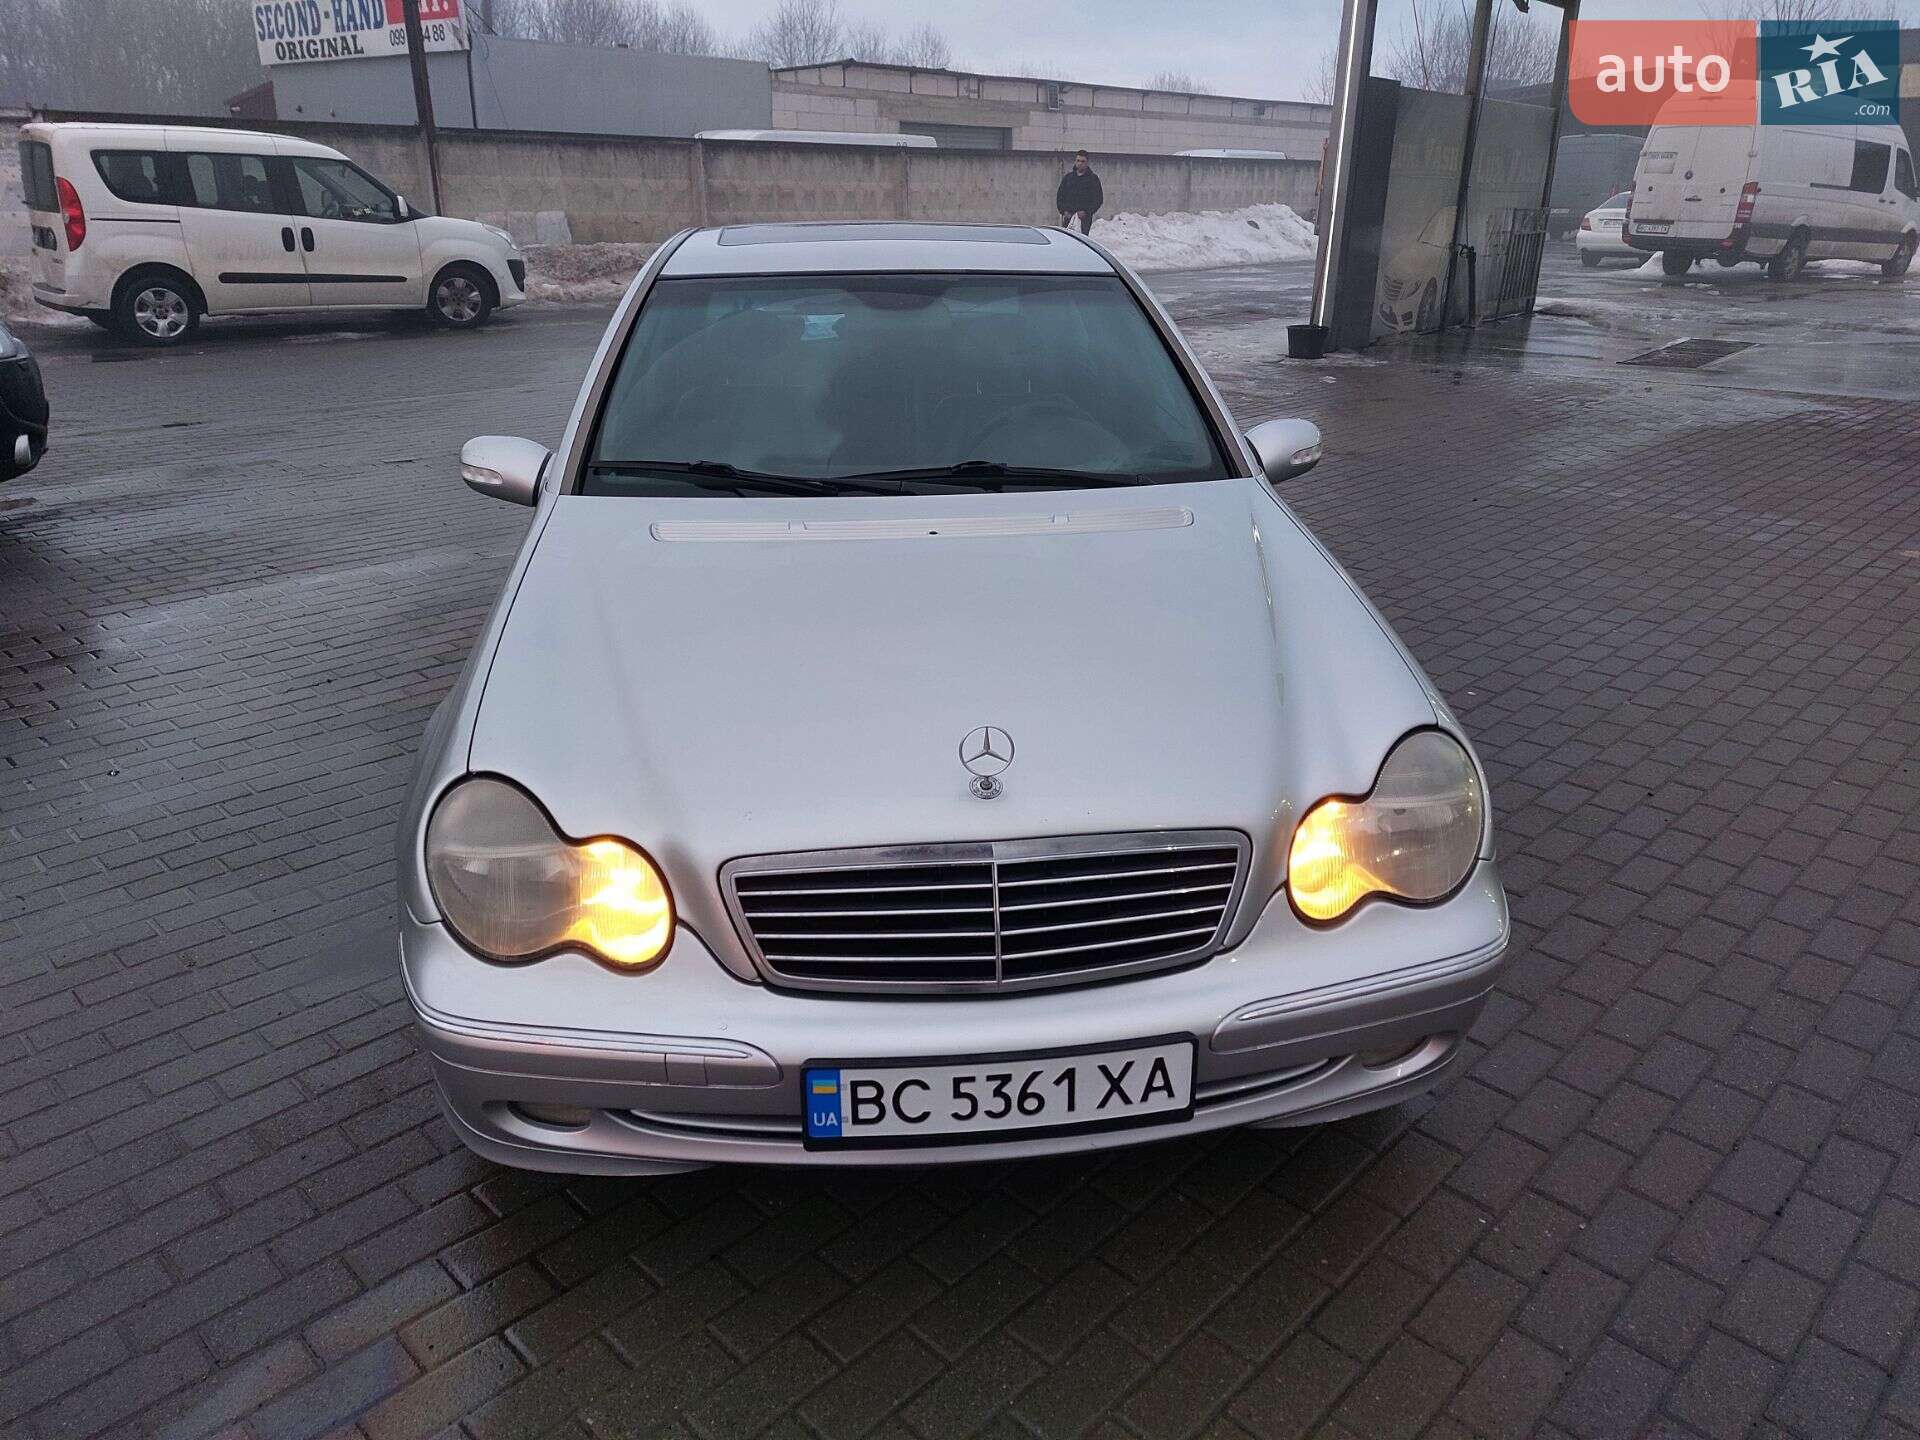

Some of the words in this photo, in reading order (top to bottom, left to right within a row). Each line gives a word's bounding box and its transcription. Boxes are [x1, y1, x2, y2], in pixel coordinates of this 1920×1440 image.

[275, 34, 365, 61] ORIGINAL
[850, 1078, 931, 1126] BC
[951, 1067, 1077, 1121] 5361
[1096, 1056, 1175, 1109] XA
[813, 1111, 838, 1127] UA
